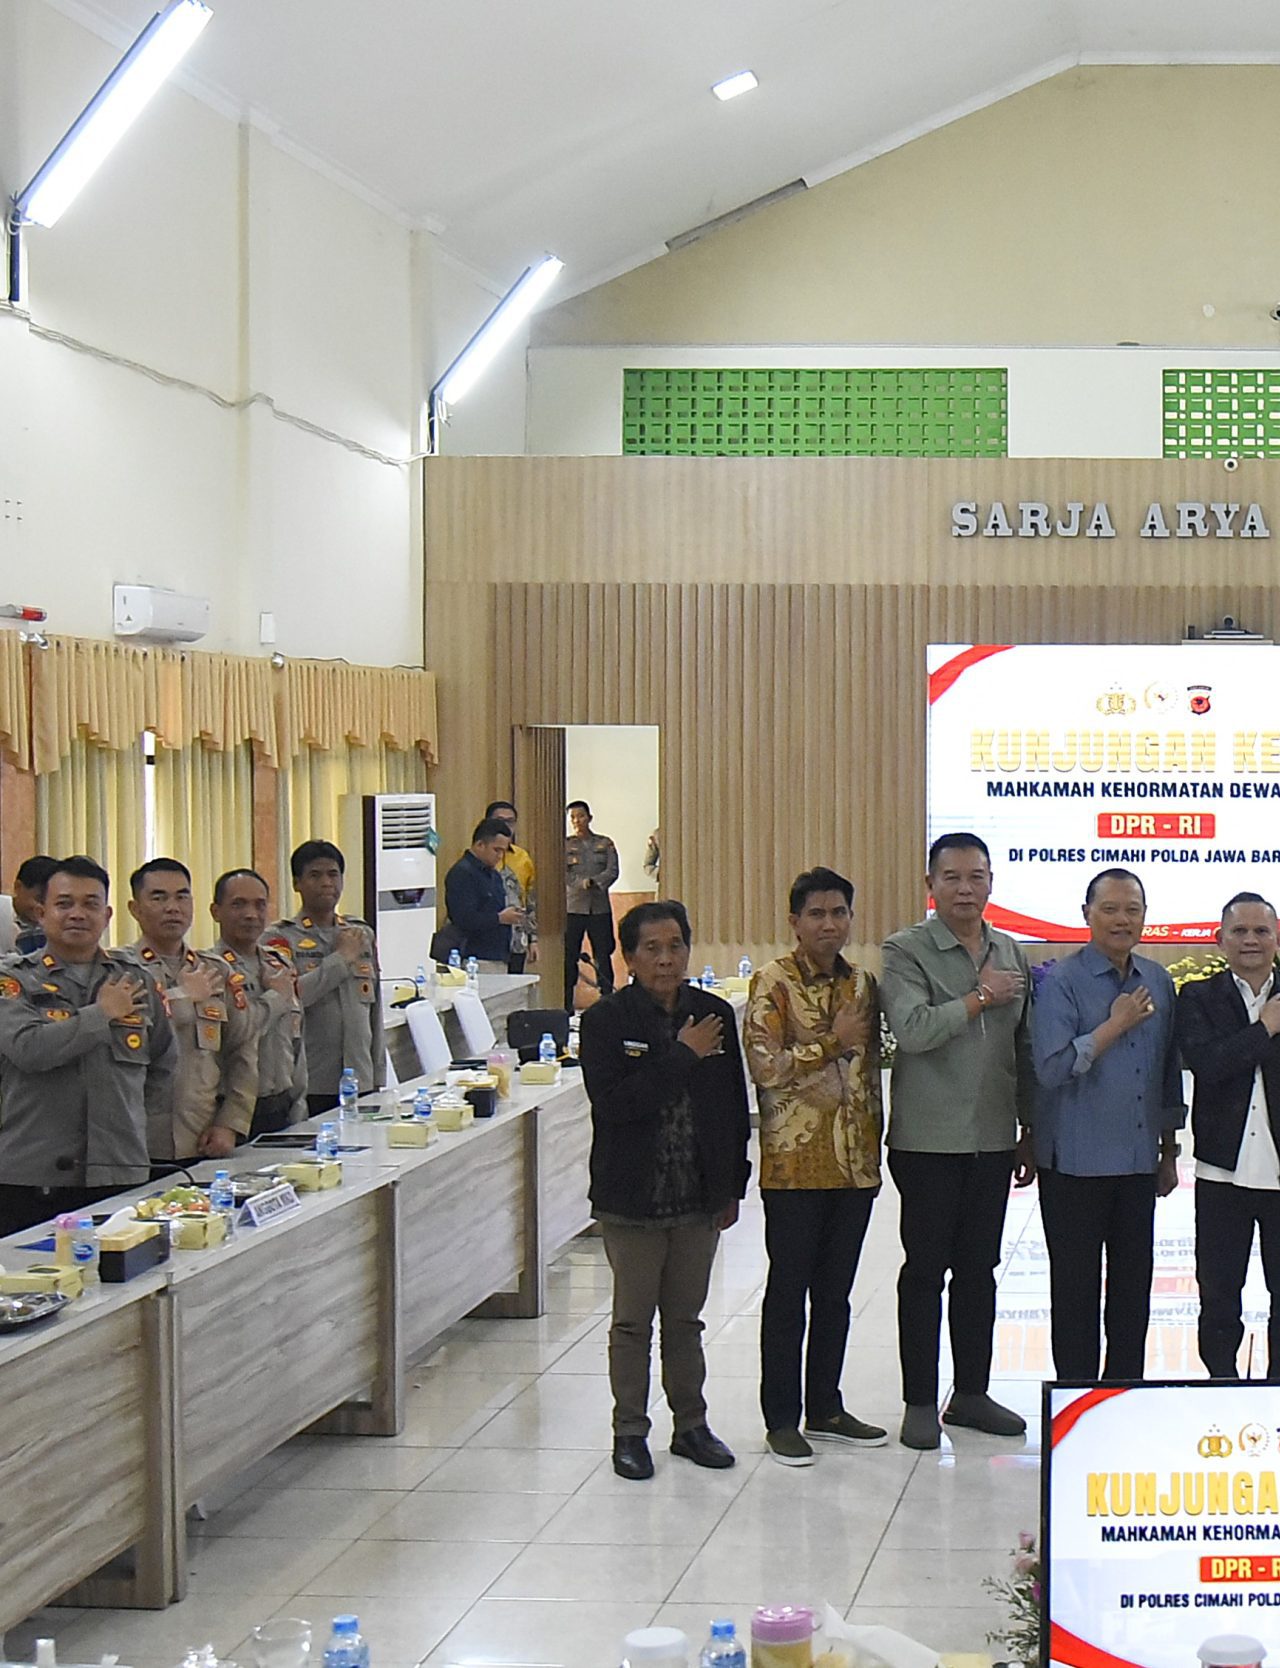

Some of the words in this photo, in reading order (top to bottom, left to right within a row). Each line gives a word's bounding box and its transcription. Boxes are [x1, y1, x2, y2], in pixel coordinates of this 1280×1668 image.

[952, 502, 1117, 538] SARJA
[1140, 503, 1270, 538] ARYA
[970, 729, 1217, 773] KUNJUNGAN
[986, 781, 1095, 798] MAHKAMAH
[1101, 782, 1224, 798] KEHORMATAN
[1110, 814, 1156, 836] DPR
[1178, 815, 1201, 836] RI
[1008, 848, 1024, 863] DI
[1028, 848, 1086, 863] POLRES
[1091, 849, 1146, 863] CIMAHI
[1151, 849, 1200, 864] POLDA
[1204, 850, 1247, 864] JAWA
[1141, 925, 1169, 938] RAS
[1101, 1525, 1197, 1542] MAHKAMAH
[1211, 1557, 1252, 1579] DPR
[1120, 1593, 1134, 1608] DI
[1138, 1593, 1190, 1608] POLRES
[1194, 1593, 1244, 1607] CIMAHI
